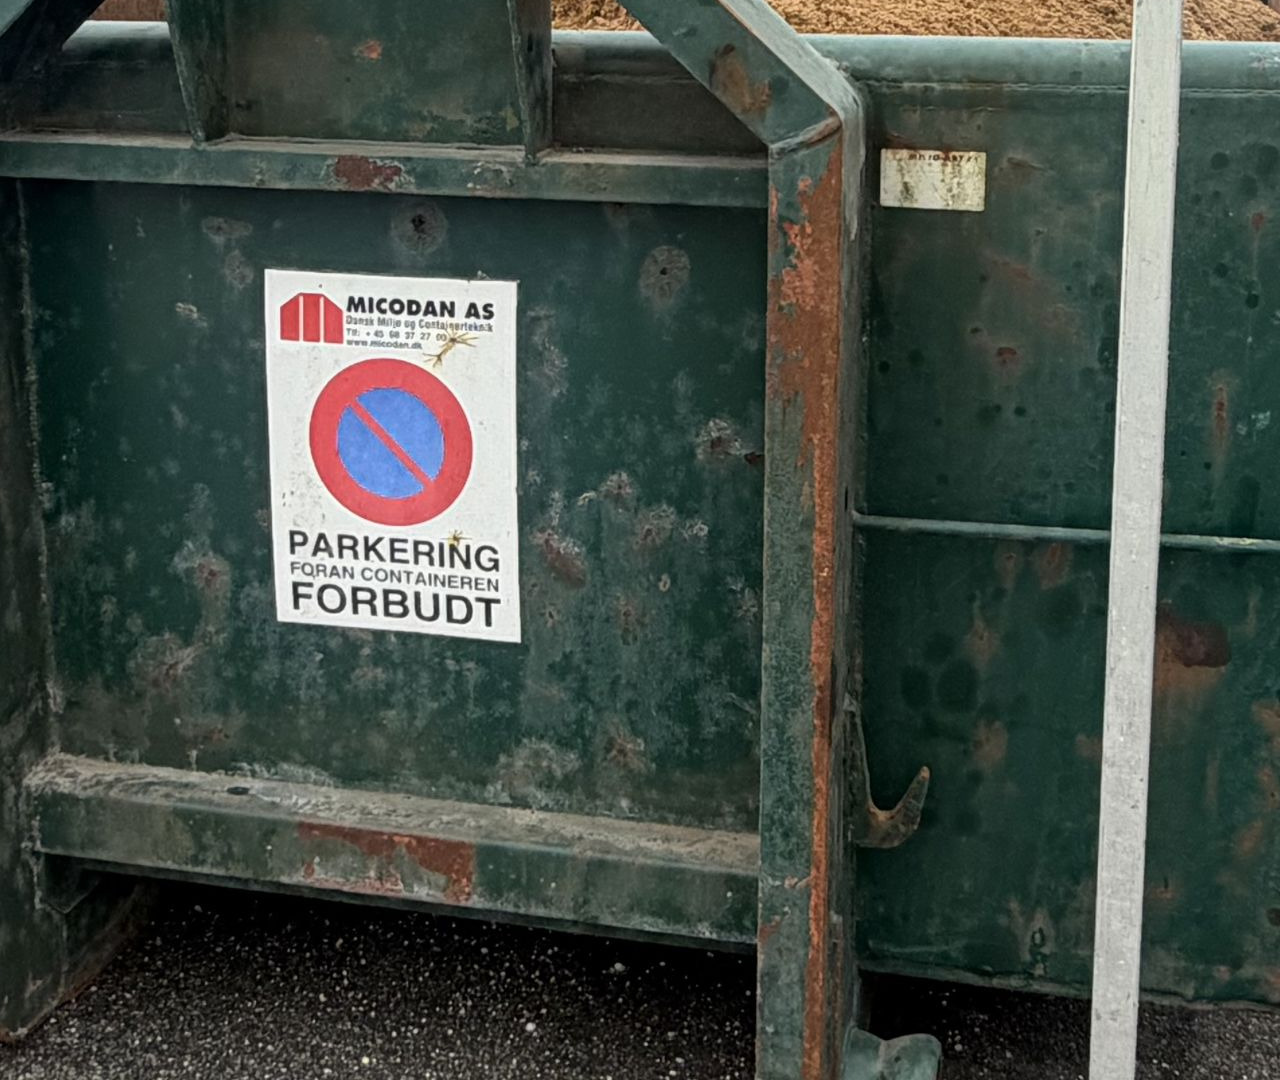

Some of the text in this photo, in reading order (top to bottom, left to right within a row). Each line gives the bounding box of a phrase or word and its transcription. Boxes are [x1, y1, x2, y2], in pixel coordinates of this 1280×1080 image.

[346, 296, 495, 320] MICODAN AS
[346, 315, 375, 327] Dansk
[404, 319, 416, 331] og
[418, 319, 494, 333] Containerteknik
[346, 339, 423, 350] www.micodan.dk
[420, 332, 431, 341] 27
[289, 530, 500, 573] PARKERING
[290, 561, 500, 593] FORAN CONTAINEREN
[292, 581, 501, 628] FORBUDT
